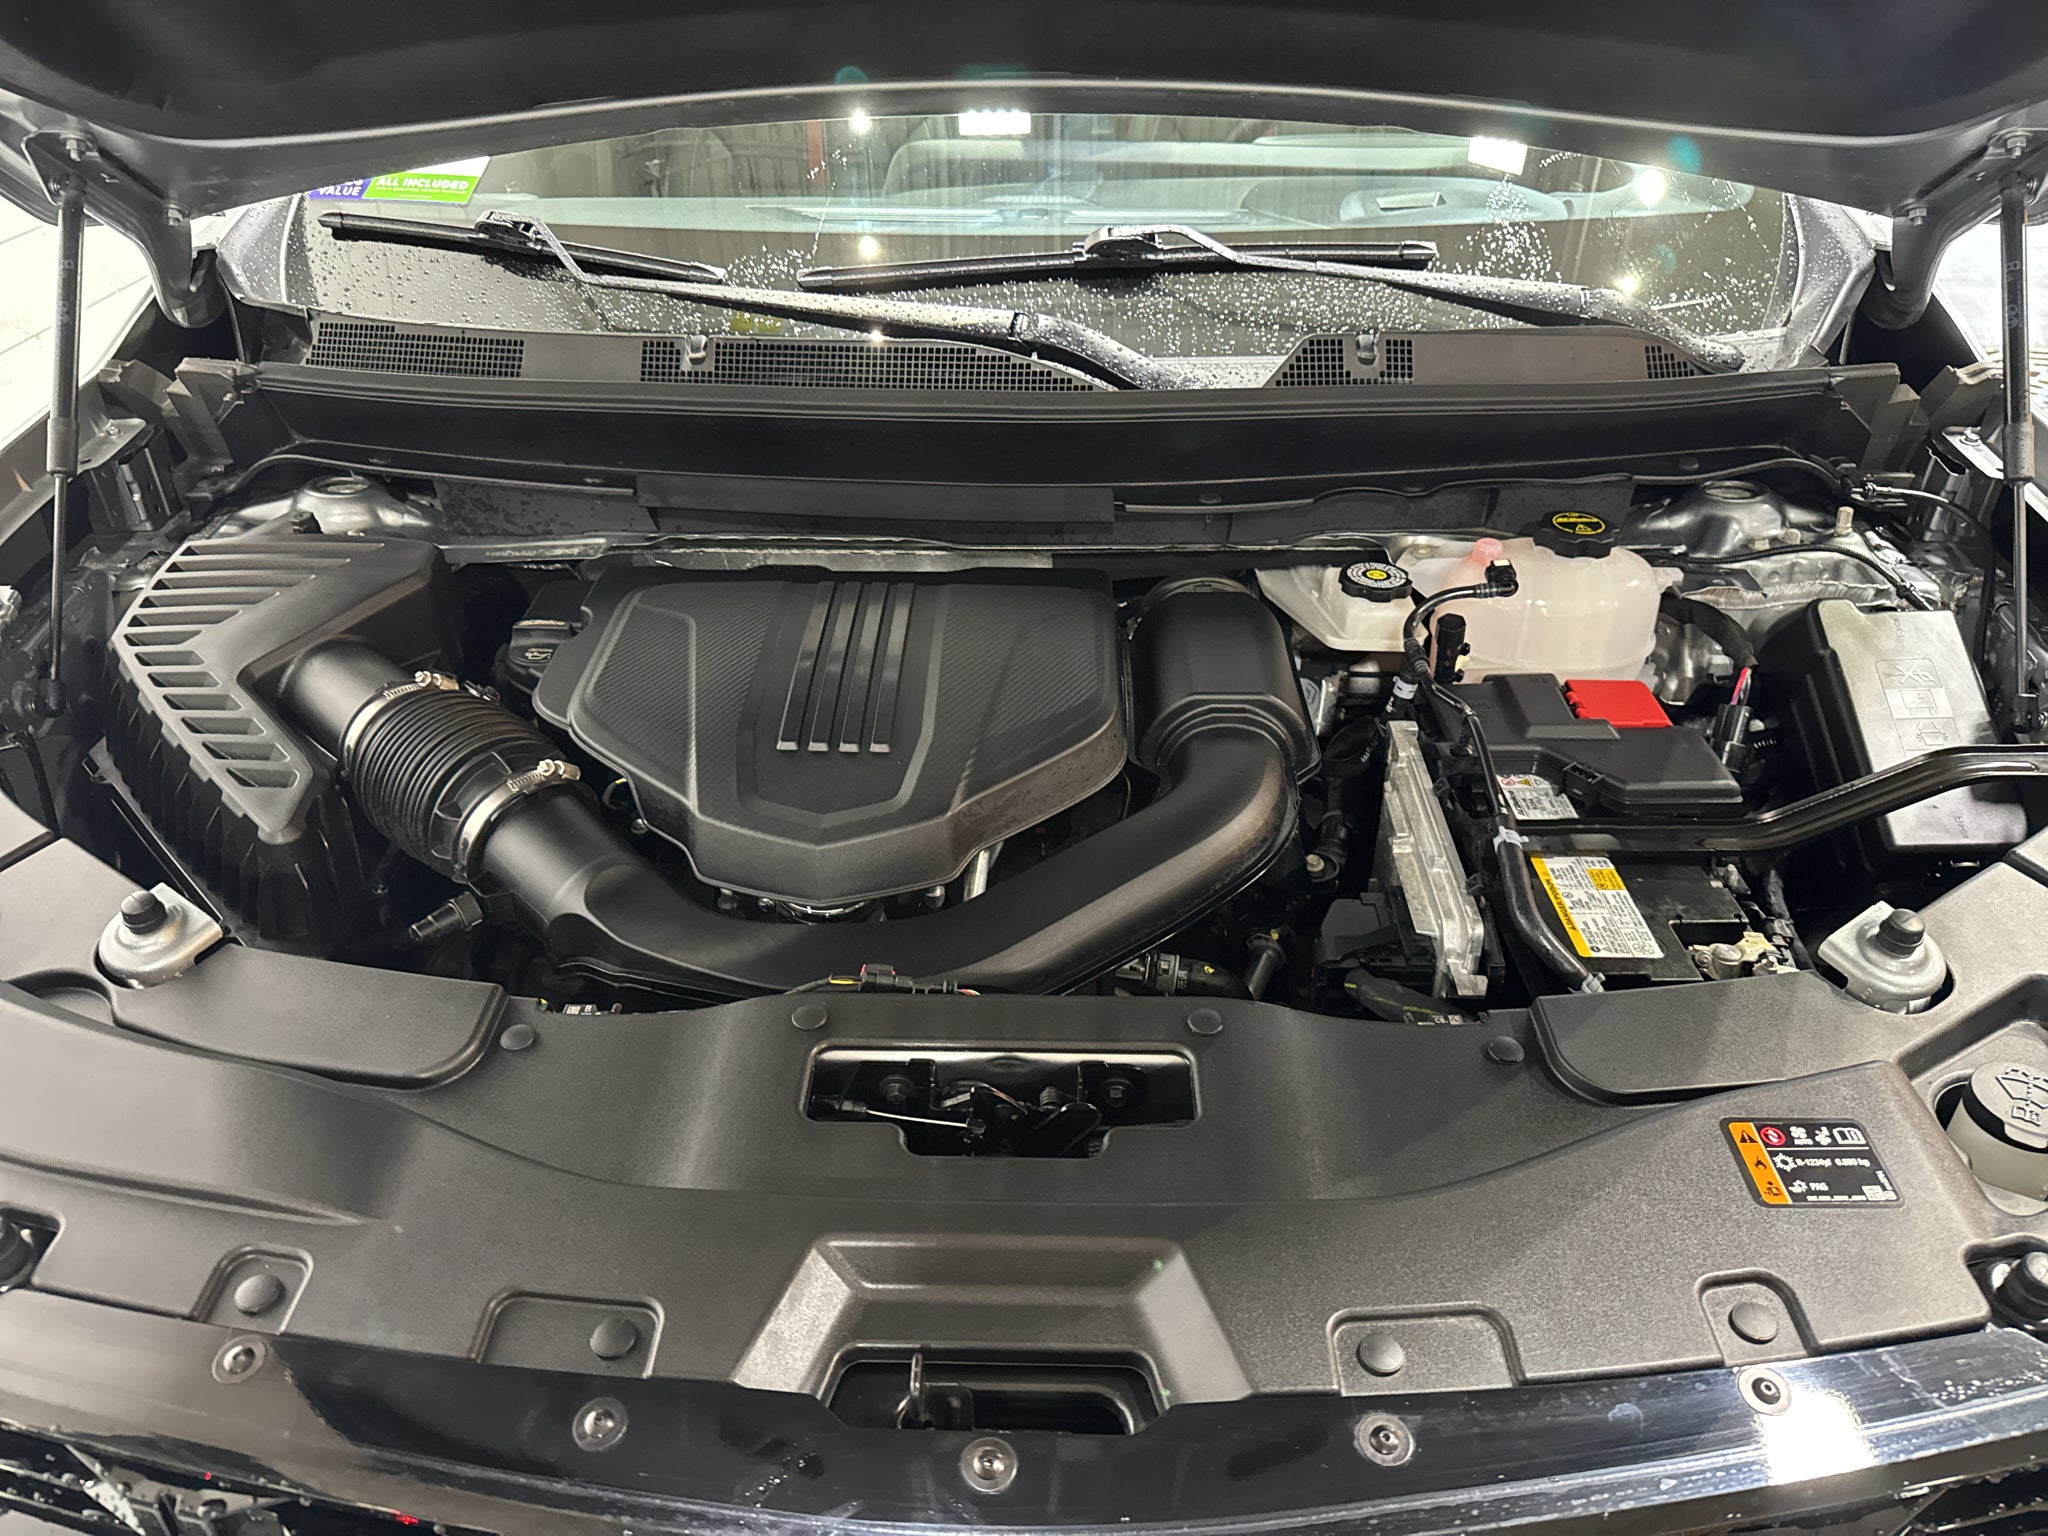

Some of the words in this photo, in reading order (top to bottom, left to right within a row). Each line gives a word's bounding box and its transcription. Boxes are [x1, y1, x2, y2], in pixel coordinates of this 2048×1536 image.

[376, 177, 399, 187] ALL
[402, 177, 470, 190] INCLUDED
[318, 186, 362, 197] VALUE
[1809, 1182, 1829, 1191] PAG
